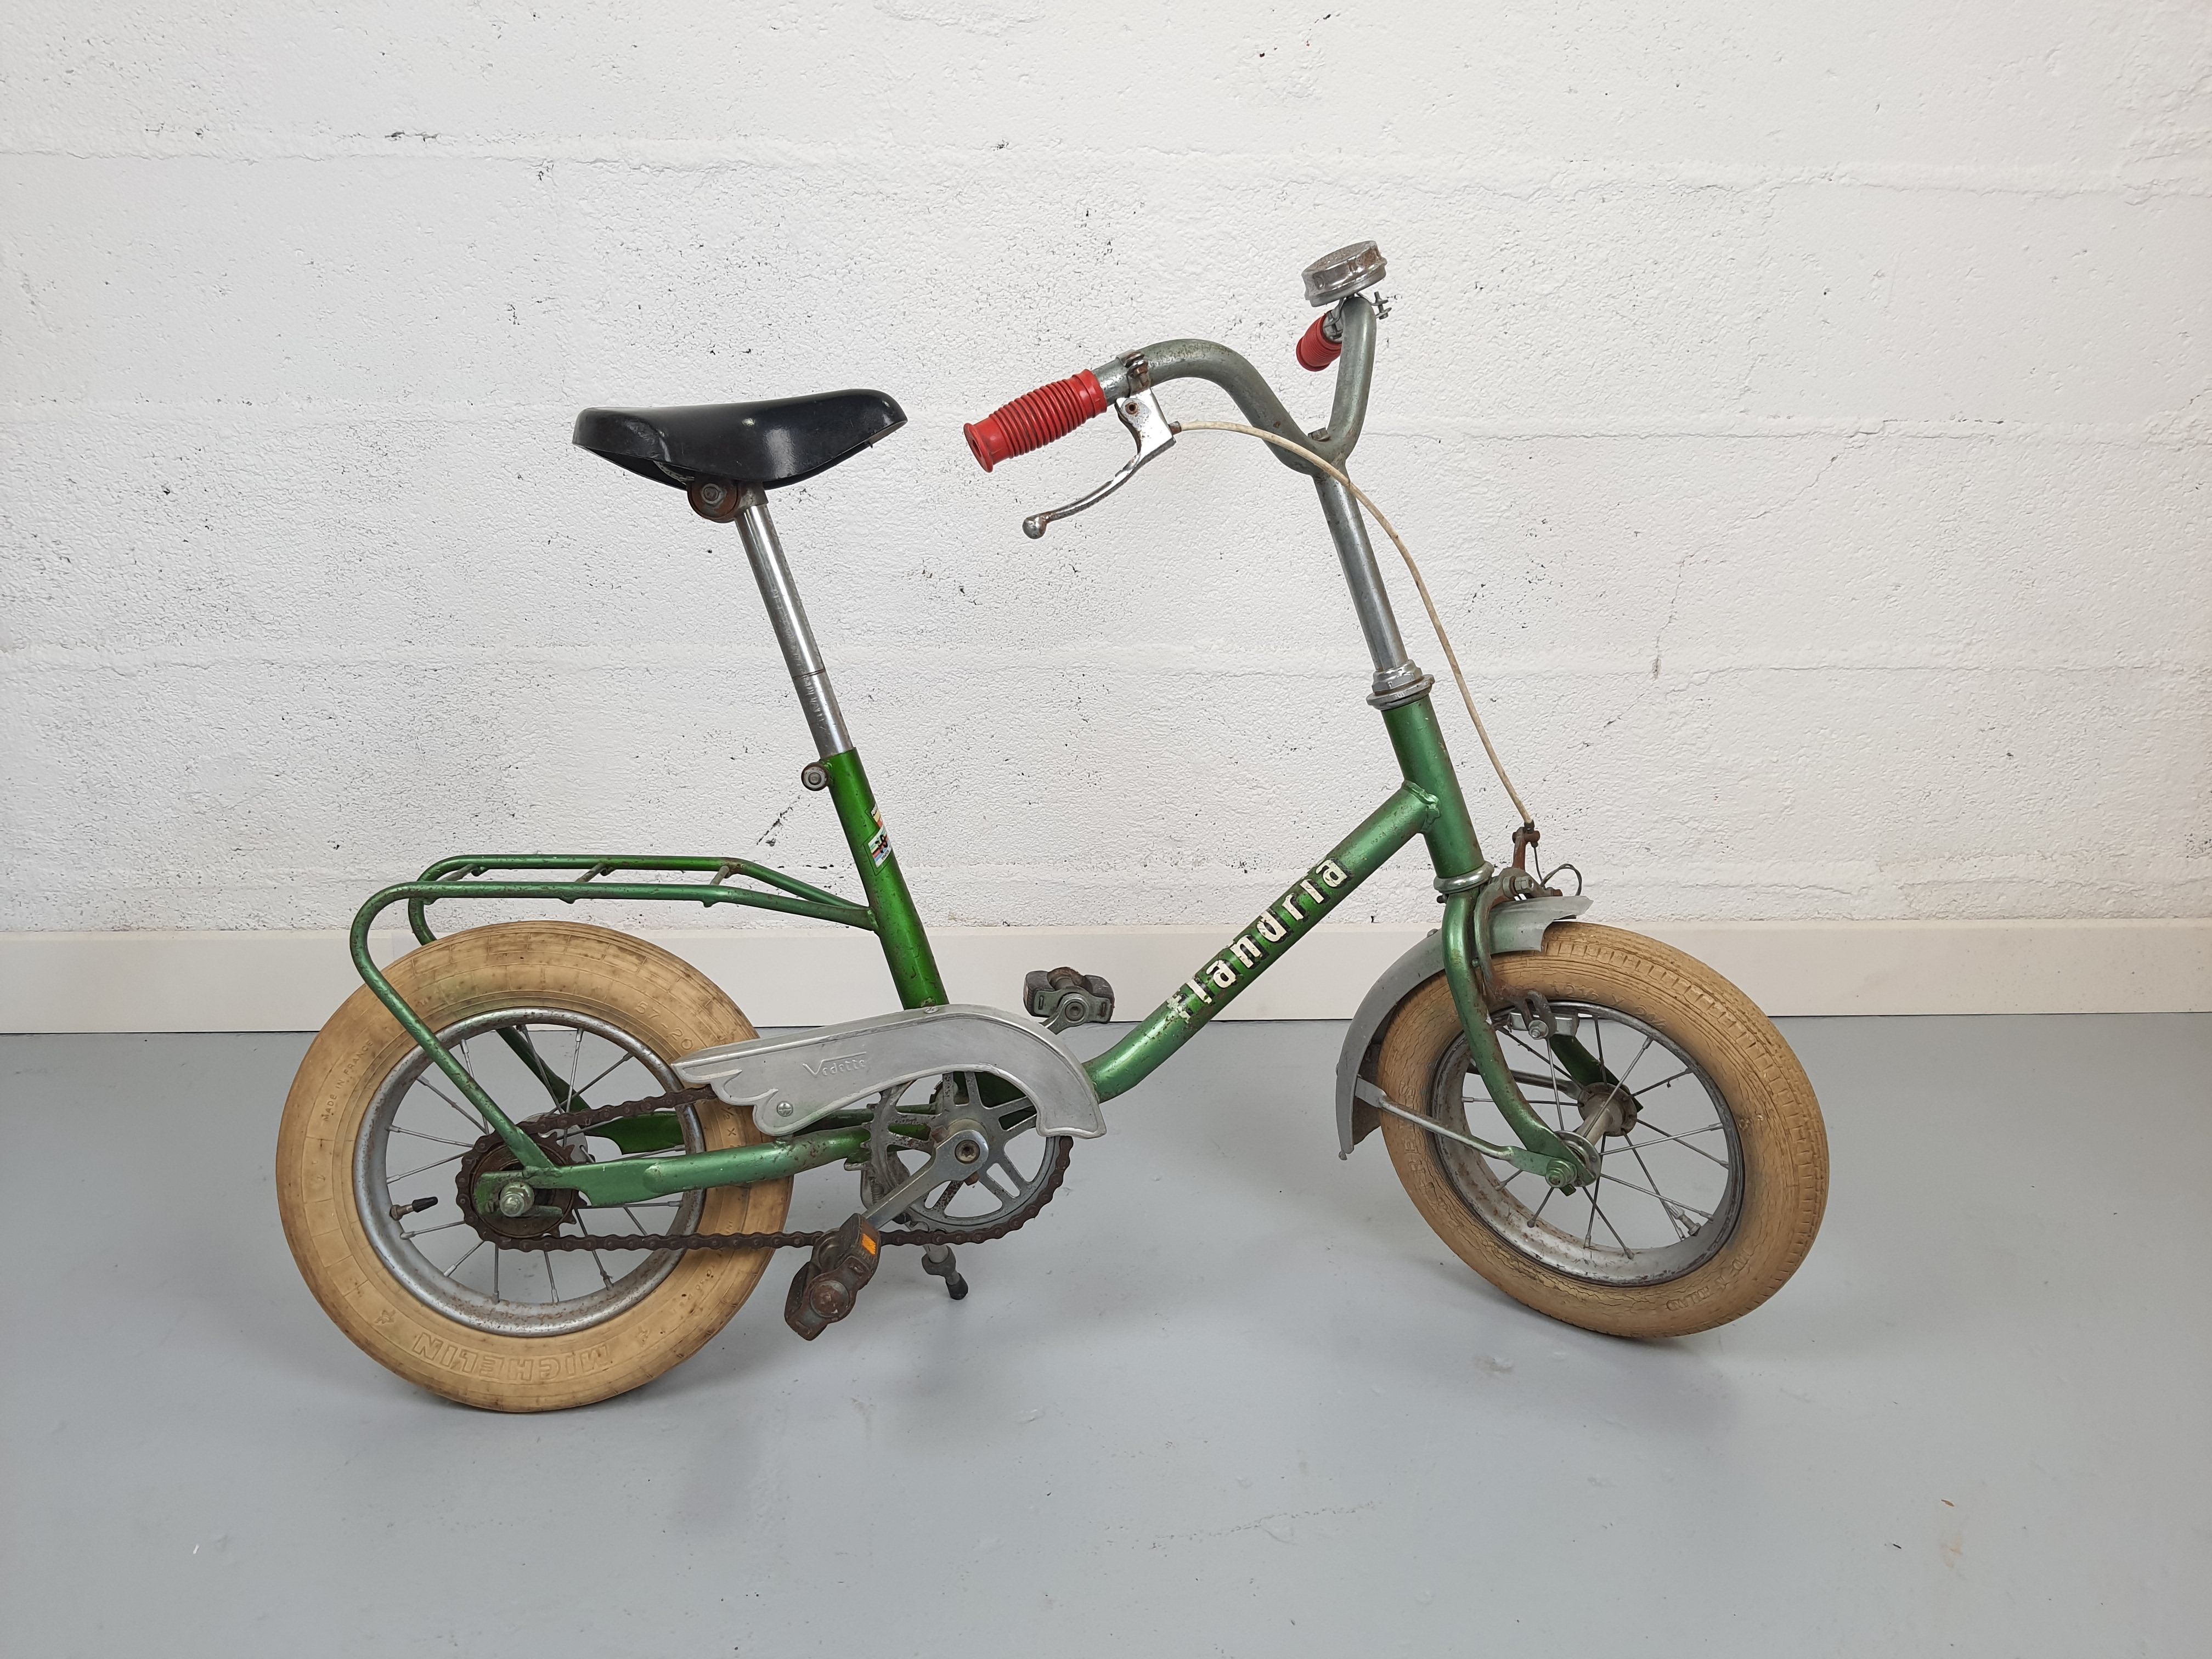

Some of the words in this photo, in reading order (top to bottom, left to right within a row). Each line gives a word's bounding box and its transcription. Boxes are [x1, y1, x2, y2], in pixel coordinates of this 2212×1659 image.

[321, 1094, 337, 1121] MADE
[335, 1079, 345, 1090] IN
[343, 1040, 374, 1075] FRANCE
[802, 1051, 867, 1078] Vedette
[411, 1332, 611, 1381] MICHELIN
